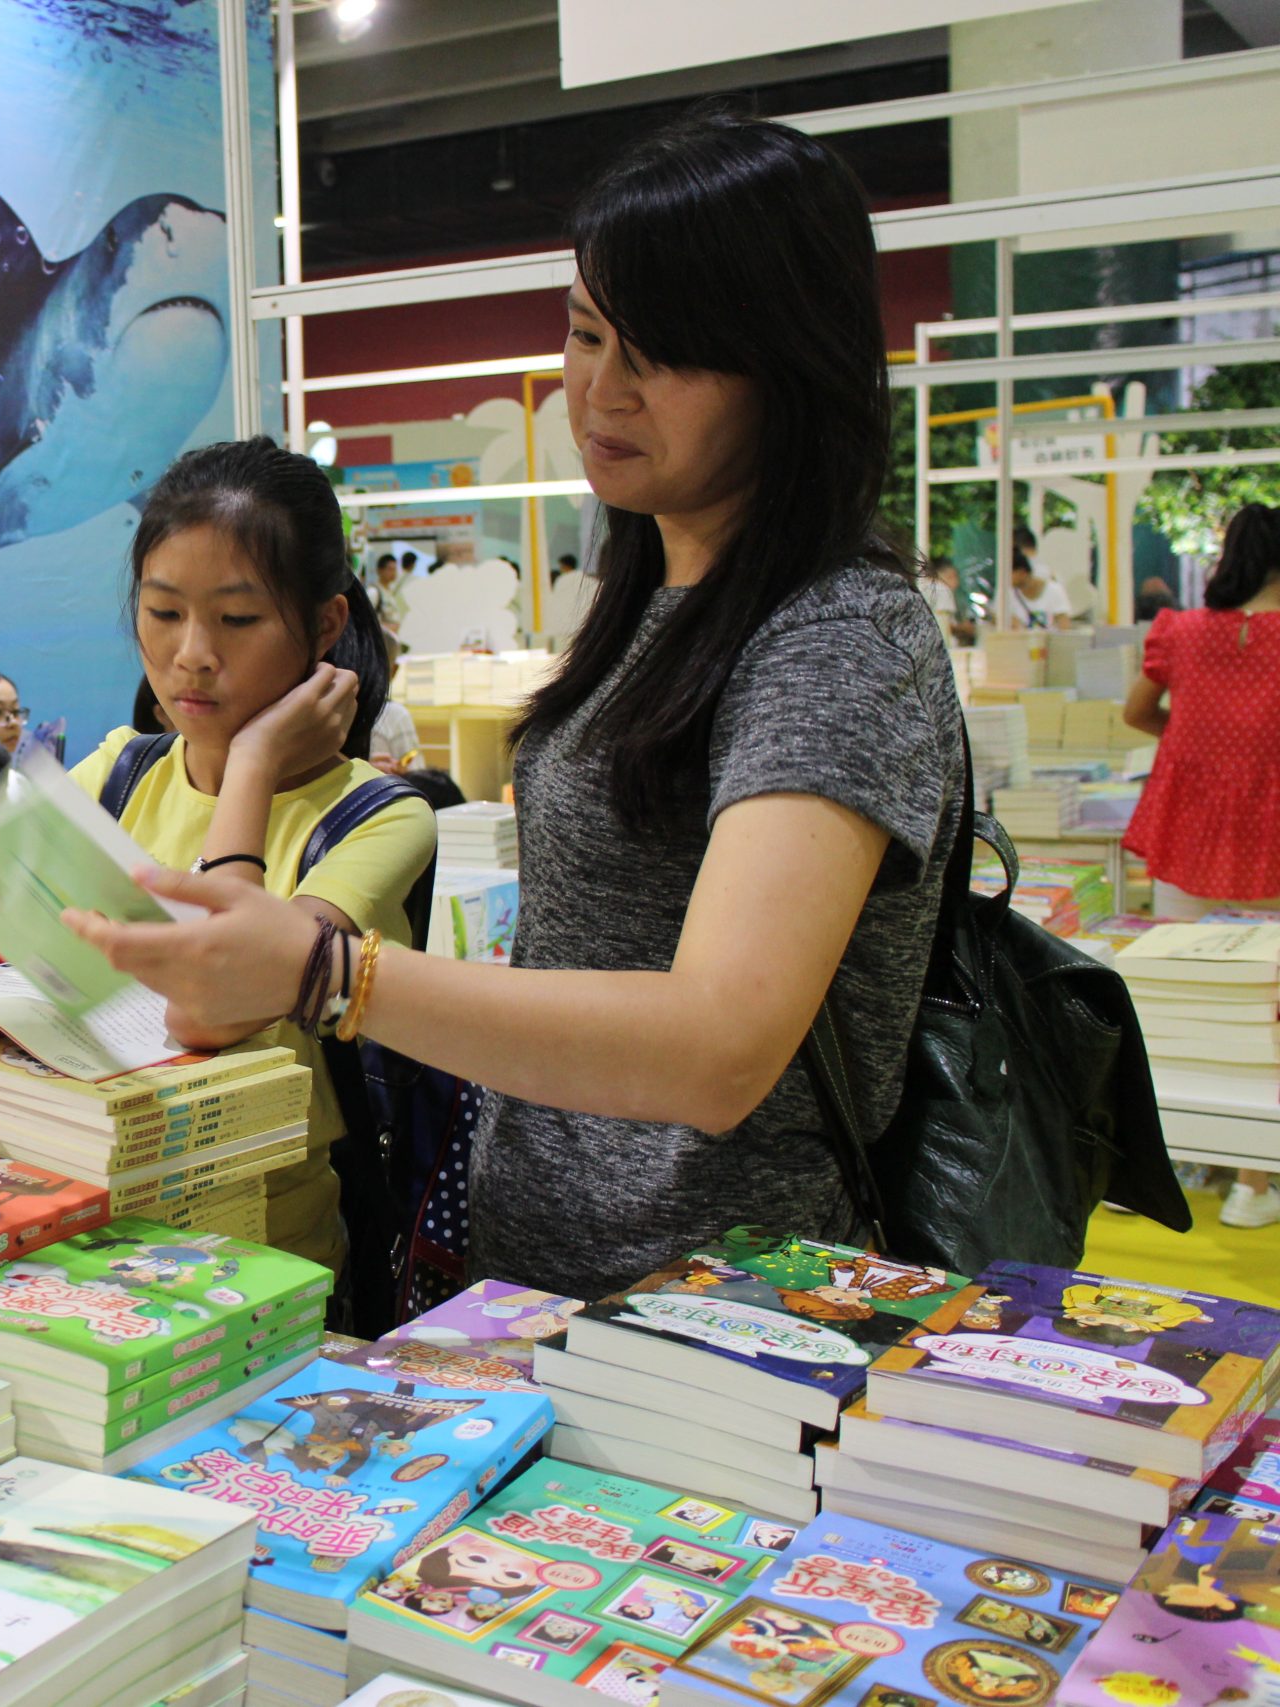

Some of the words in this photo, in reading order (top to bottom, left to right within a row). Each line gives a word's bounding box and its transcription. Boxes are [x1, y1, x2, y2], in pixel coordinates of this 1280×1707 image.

[492, 1513, 639, 1561] 我的友谊
[536, 1506, 625, 1542] 生病了
[777, 1572, 934, 1626] 轻轻听
